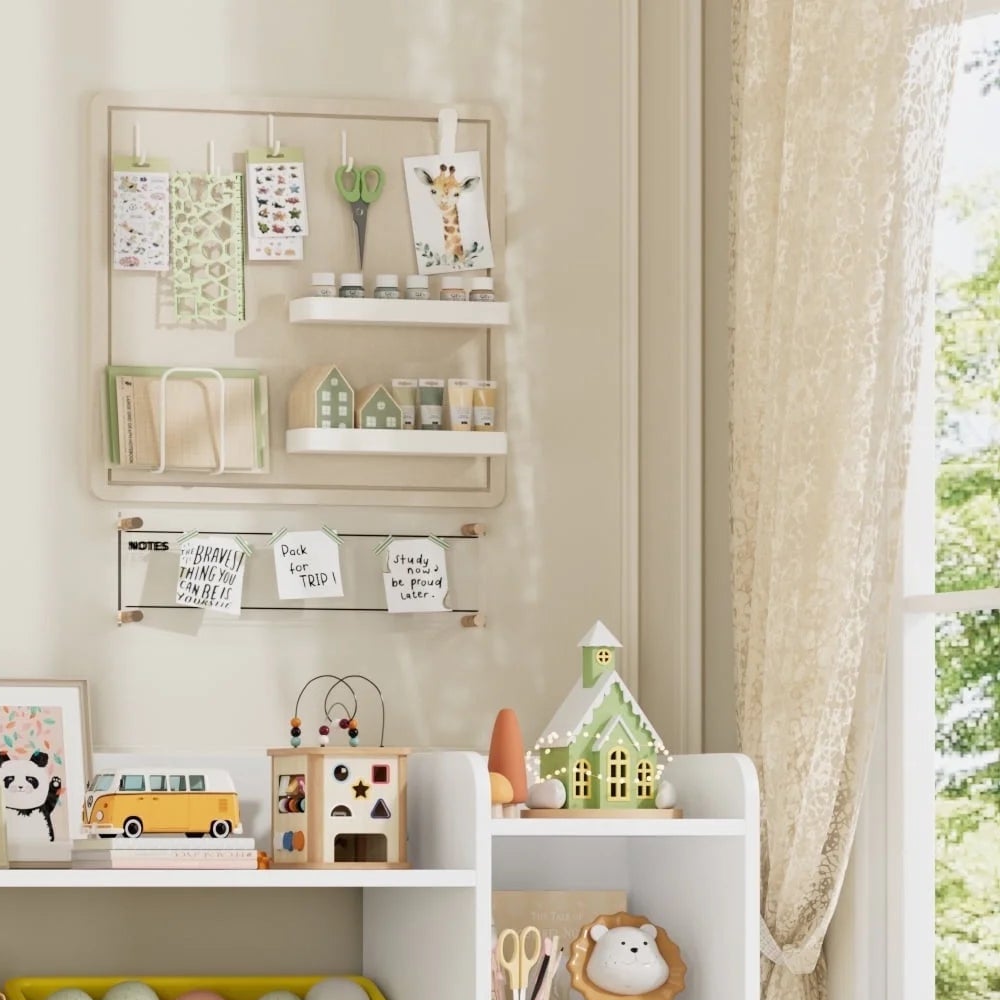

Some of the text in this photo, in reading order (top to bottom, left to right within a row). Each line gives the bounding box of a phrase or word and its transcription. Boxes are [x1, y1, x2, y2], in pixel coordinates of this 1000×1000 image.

[128, 541, 169, 551] NOTES
[281, 544, 308, 557] Pack
[290, 562, 309, 575] for
[179, 565, 237, 586] THING YOU
[391, 576, 443, 590] be proud
[180, 580, 233, 600] CAN BE IS
